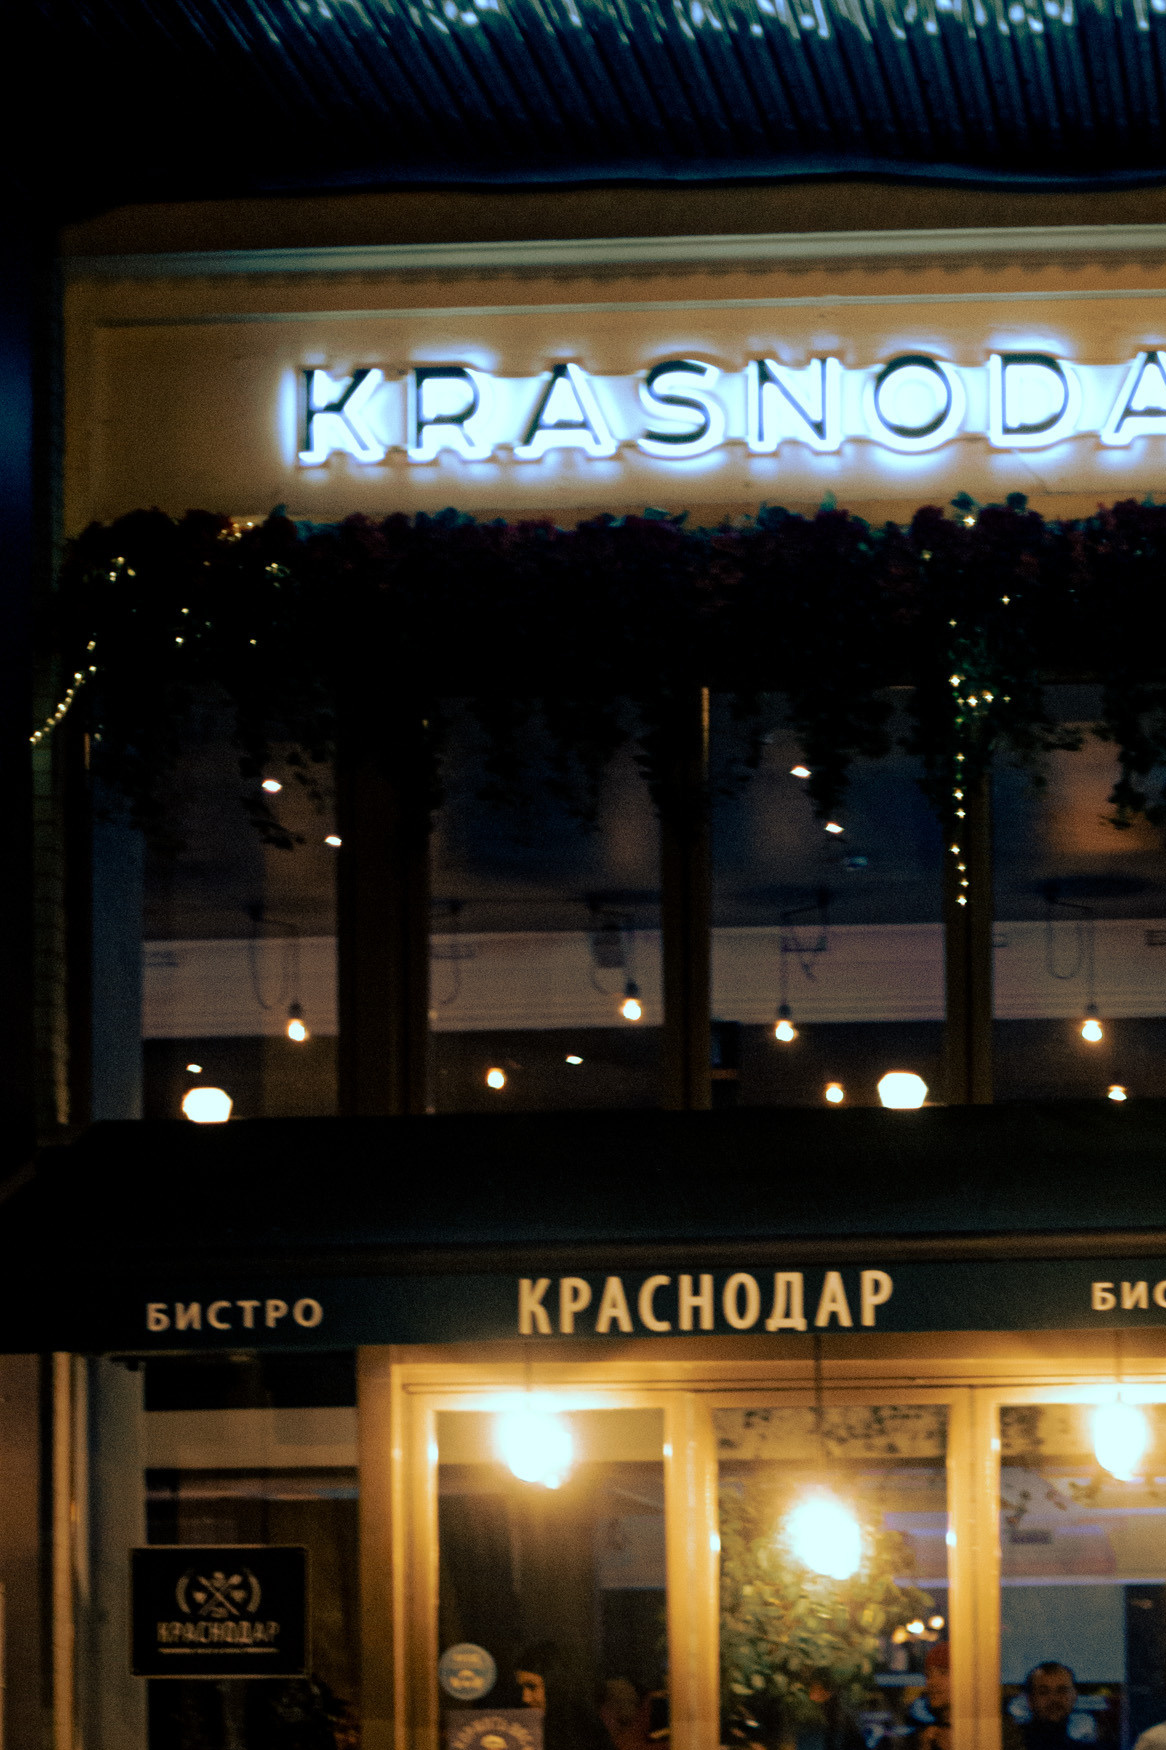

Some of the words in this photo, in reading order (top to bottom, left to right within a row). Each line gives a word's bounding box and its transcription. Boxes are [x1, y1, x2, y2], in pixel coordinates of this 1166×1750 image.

[146, 1298, 323, 1331] БИСТРО
[517, 1269, 894, 1335] КРАСНОДАР
[157, 1620, 280, 1644] КРАСНОДАР
